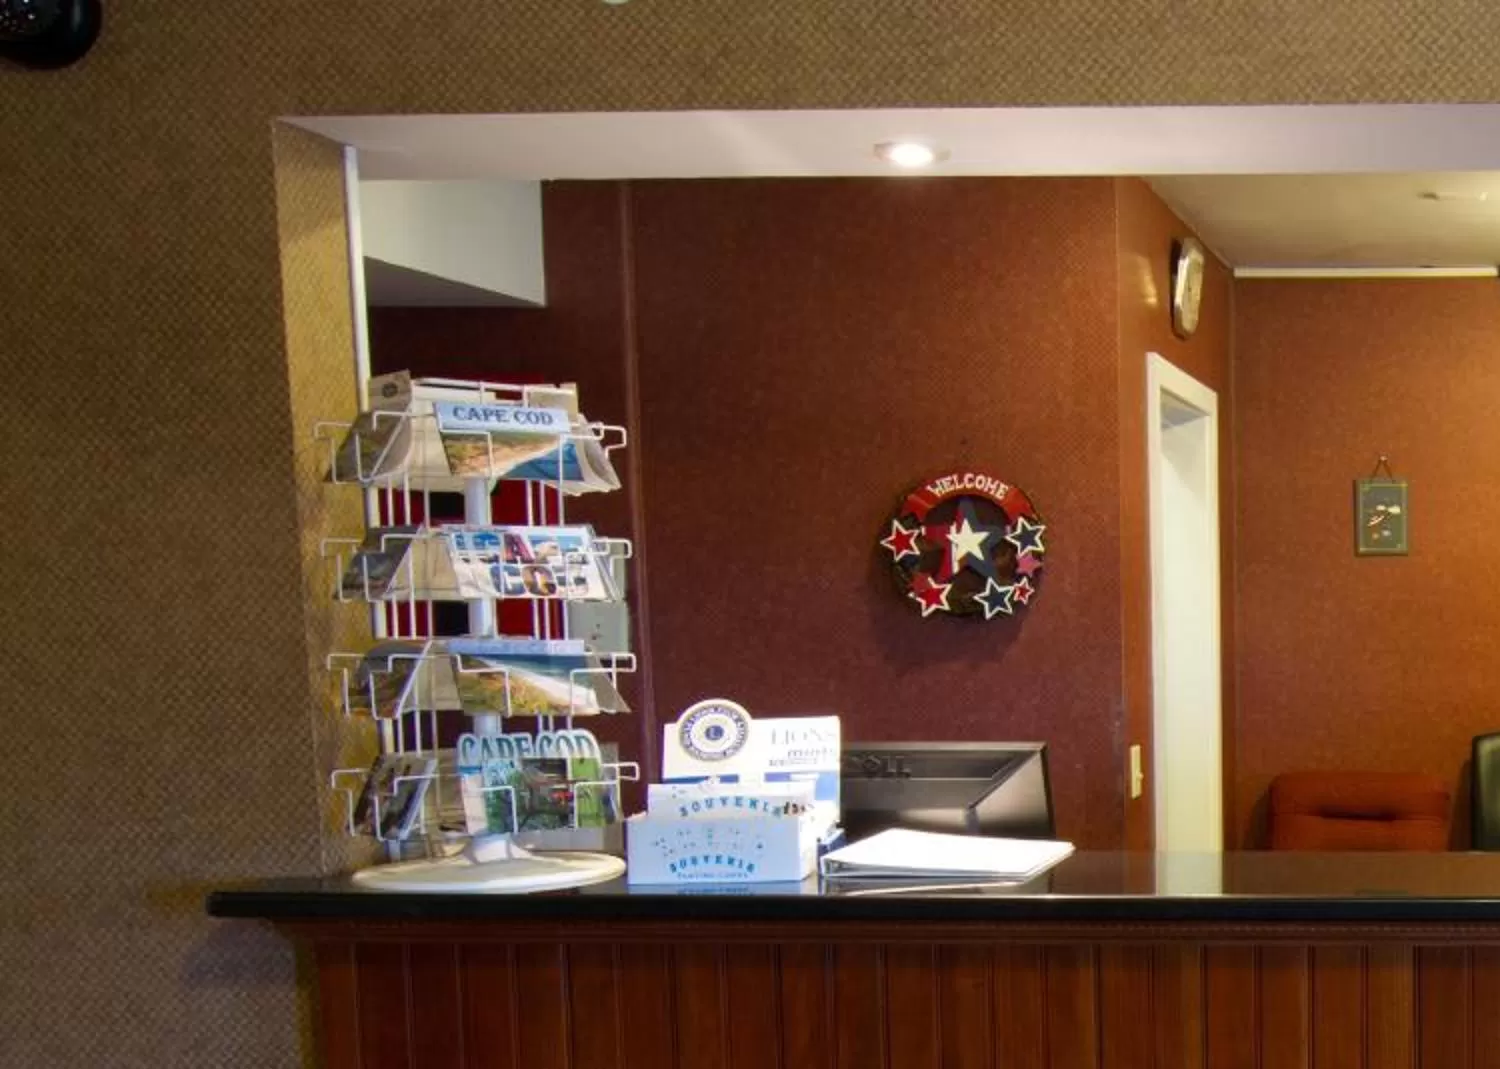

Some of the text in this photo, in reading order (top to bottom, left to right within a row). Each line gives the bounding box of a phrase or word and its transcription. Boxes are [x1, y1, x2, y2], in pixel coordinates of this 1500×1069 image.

[452, 405, 554, 426] CAPE COD
[925, 472, 1009, 500] WELCOME
[536, 734, 595, 758] COD
[679, 796, 784, 818] SOUVENIR
